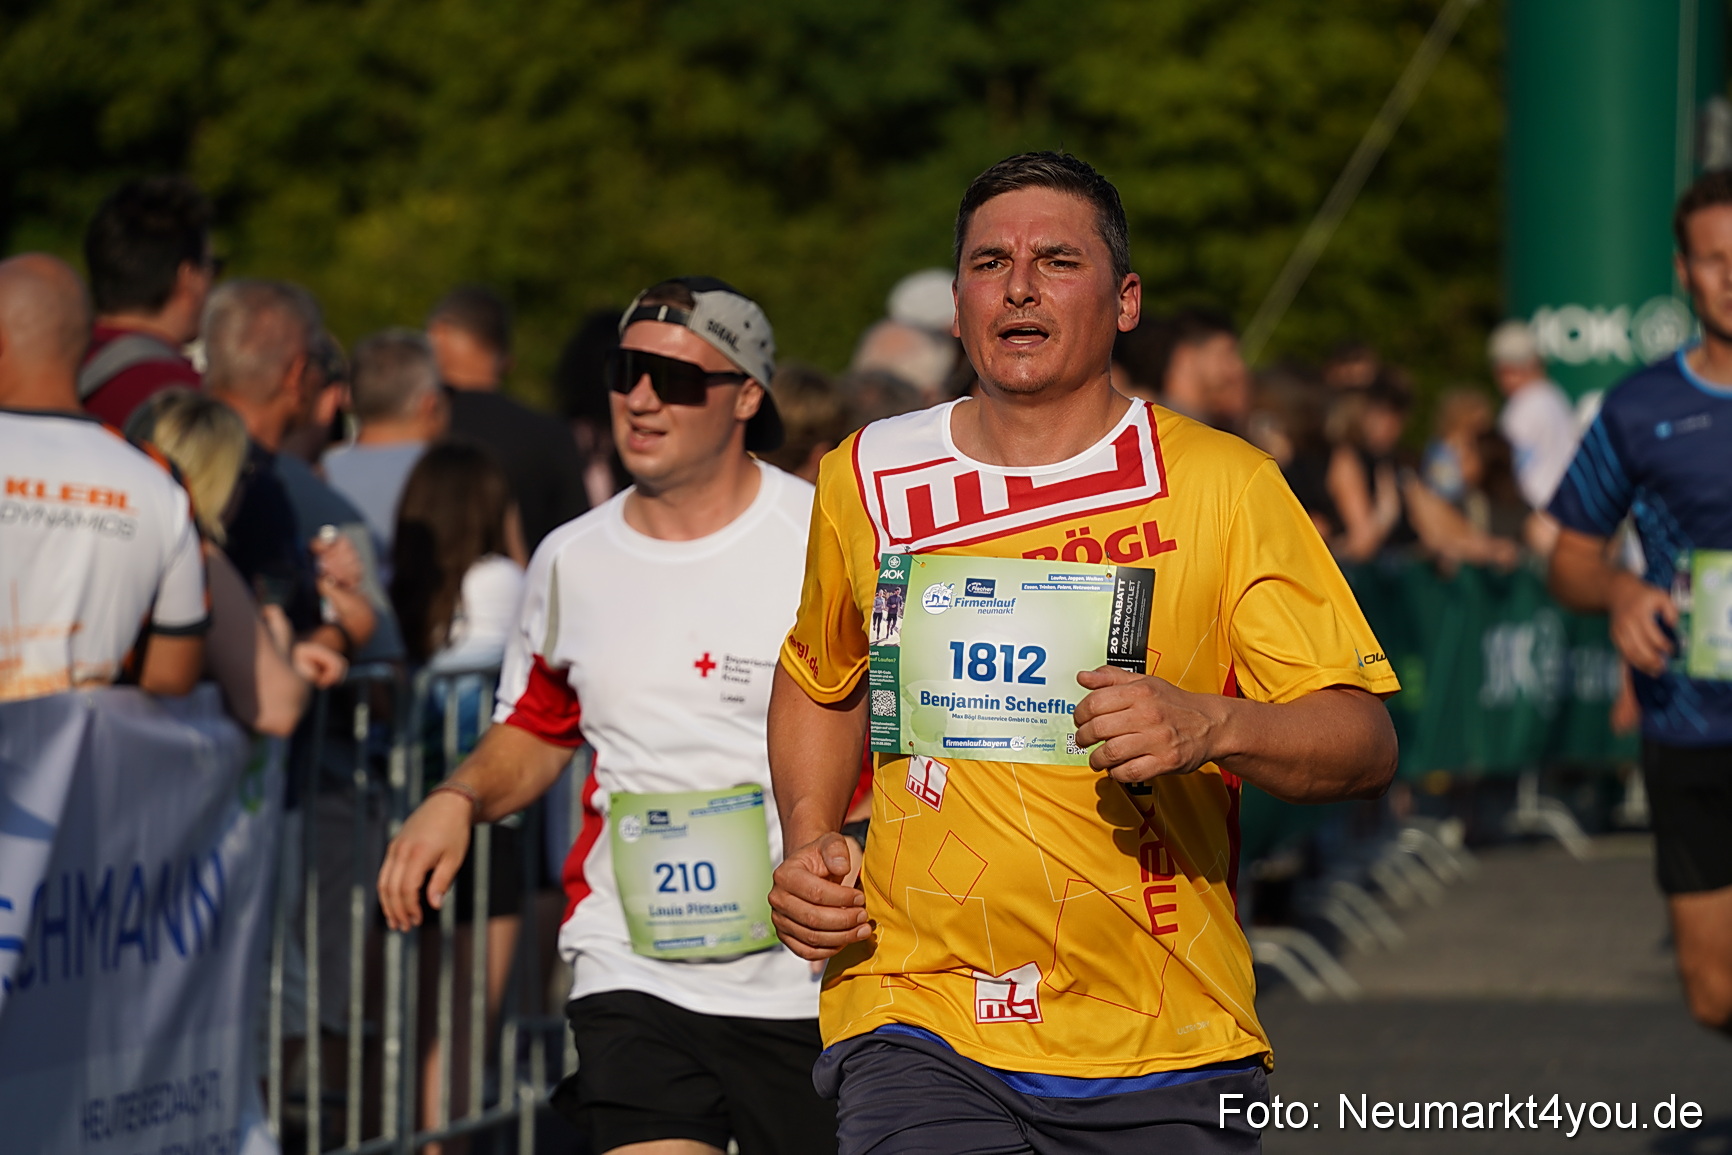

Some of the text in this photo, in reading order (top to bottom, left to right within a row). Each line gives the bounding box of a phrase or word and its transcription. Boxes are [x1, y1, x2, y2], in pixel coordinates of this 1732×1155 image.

[880, 569, 905, 580] AOK
[954, 597, 1017, 608] Firmenlauf
[1109, 578, 1126, 654] 20 % RABATT
[1121, 615, 1131, 655] FACTORY
[1126, 580, 1136, 615] OUTLET
[950, 641, 1047, 685] 1812
[920, 691, 1076, 715] Benjamin Scheffle
[964, 713, 977, 721] Bögl
[977, 714, 1008, 722] Bauservice
[945, 739, 1008, 748] firmenlauf.bayern
[655, 861, 717, 892] 210
